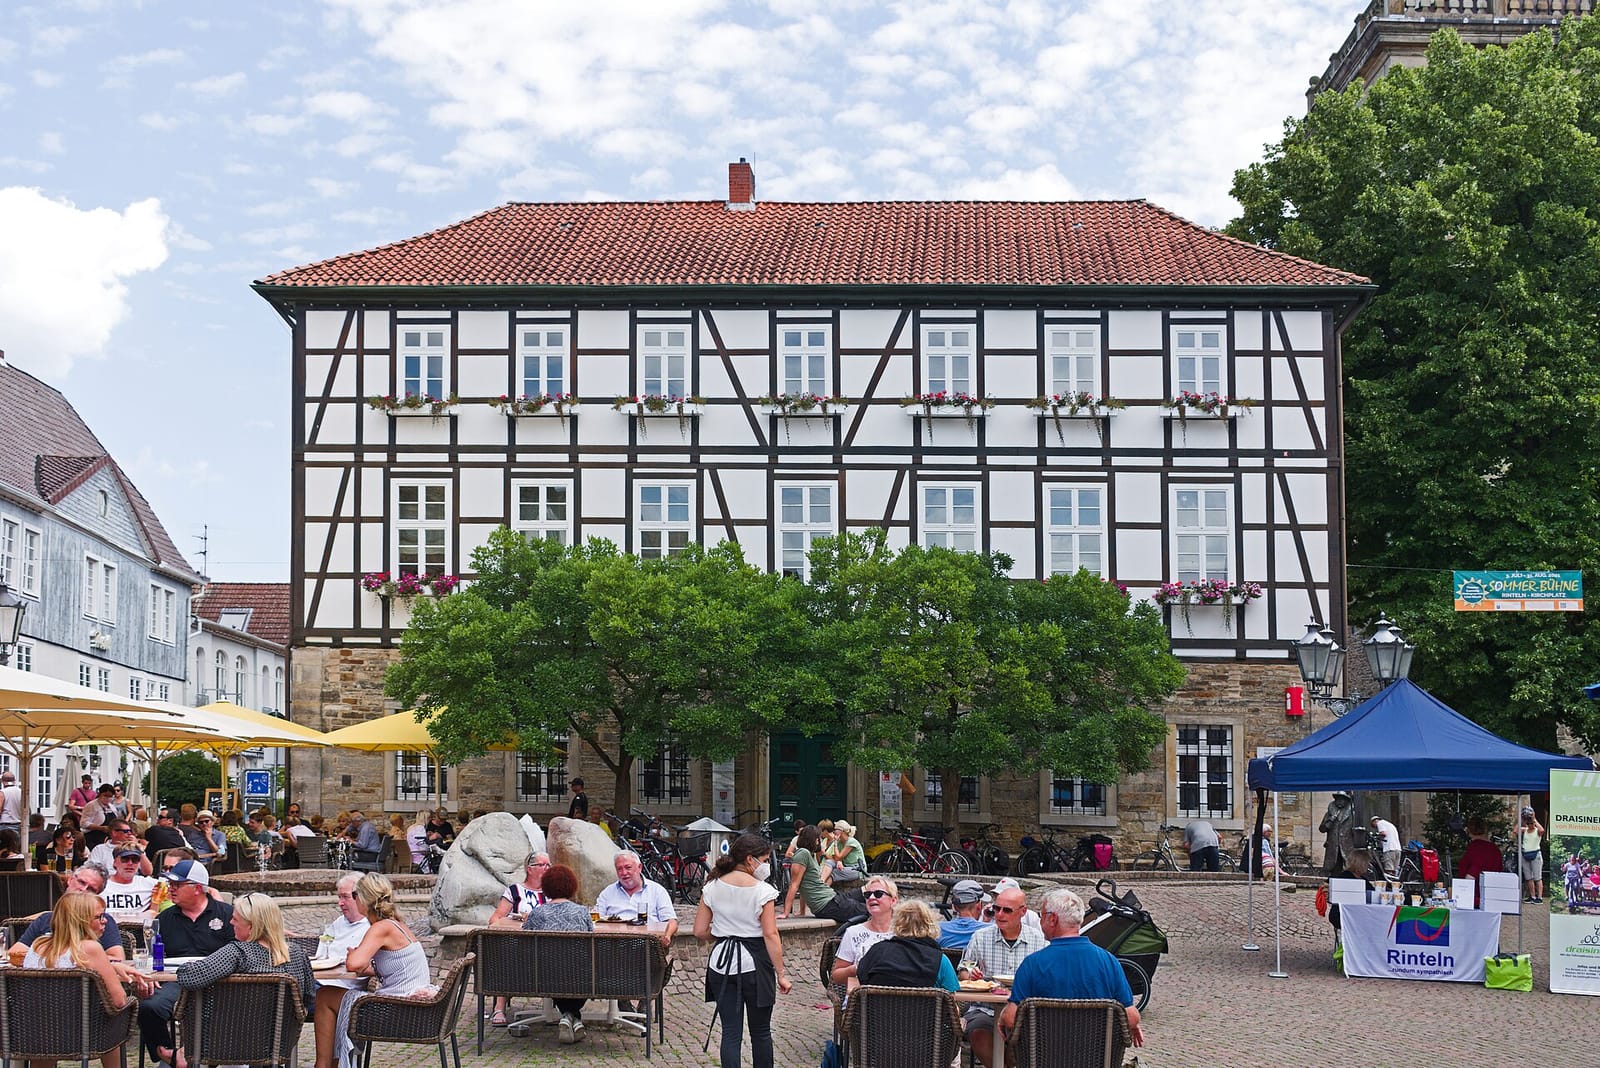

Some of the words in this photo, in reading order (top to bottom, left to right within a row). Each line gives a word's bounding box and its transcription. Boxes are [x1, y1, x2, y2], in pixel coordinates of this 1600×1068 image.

[1489, 578, 1579, 592] SOMMER-BÜHNE
[1555, 814, 1600, 824] DRAISINE
[1387, 949, 1454, 968] Rinteln
[1416, 968, 1454, 976] sympathisch
